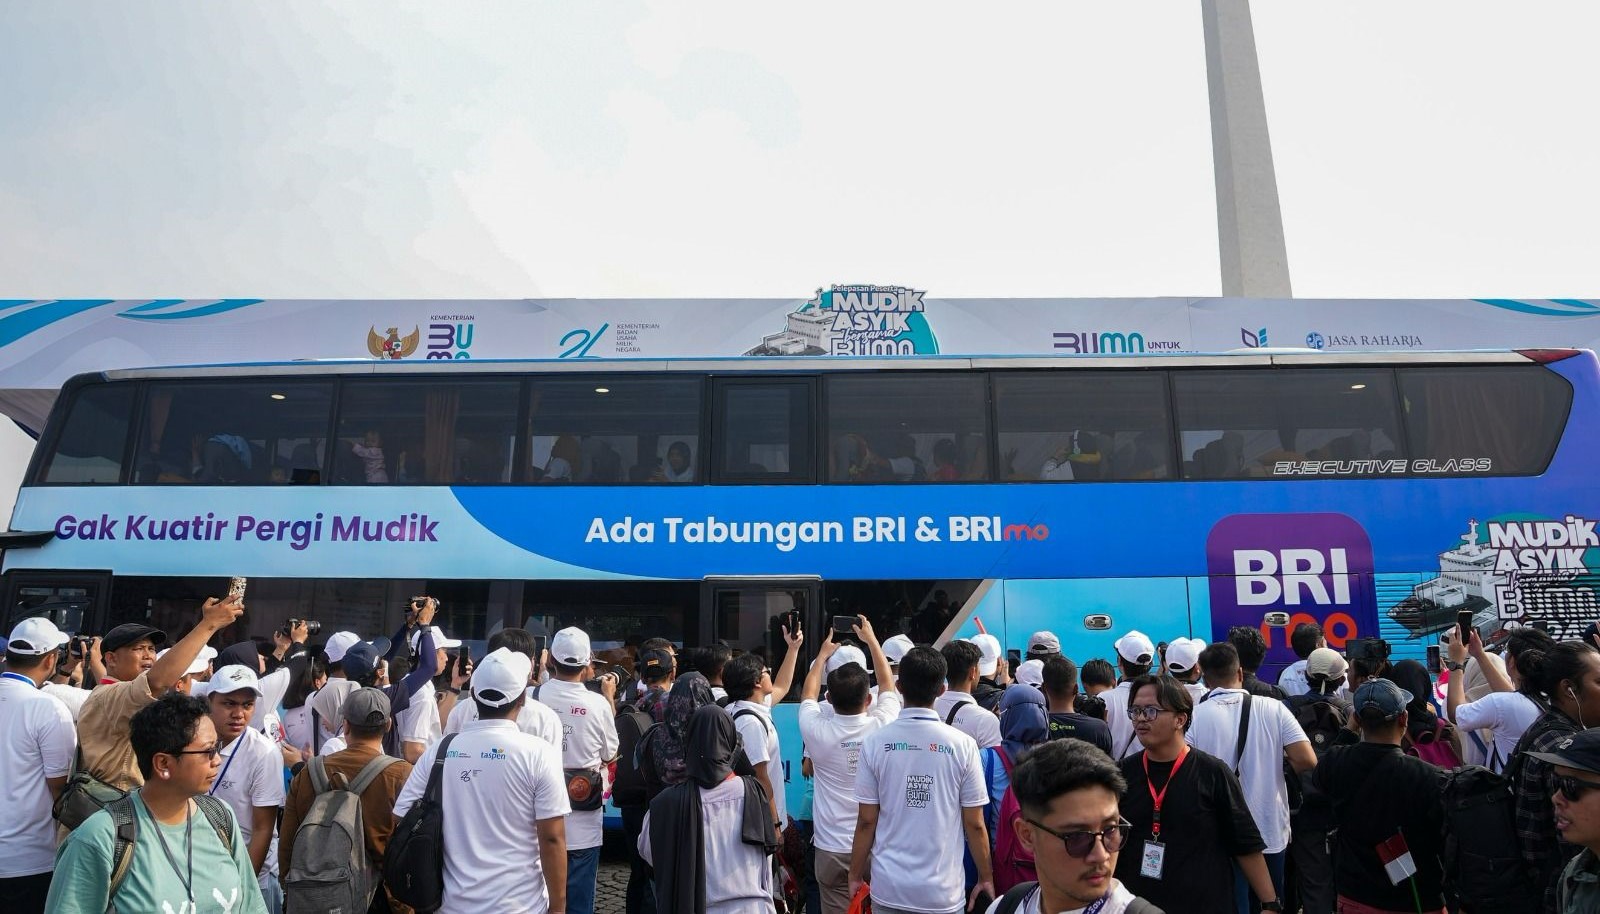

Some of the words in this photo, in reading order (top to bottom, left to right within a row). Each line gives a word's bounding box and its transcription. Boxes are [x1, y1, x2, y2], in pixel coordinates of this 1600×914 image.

[831, 312, 911, 331] ASYIK
[842, 328, 902, 345] bersama
[1328, 336, 1357, 347] JASA
[1361, 335, 1422, 347] RAHARJA
[1147, 341, 1180, 349] UNTUK
[1273, 459, 1407, 474] EXECUTIVE
[1411, 458, 1492, 473] CLASS
[54, 514, 118, 541] Gak
[125, 513, 228, 541] Kuatir
[235, 513, 324, 551] Pergi
[331, 513, 440, 542] Mudik
[584, 518, 654, 543] Ada
[664, 517, 843, 552] Tabungan
[852, 517, 906, 542] BRI
[914, 517, 941, 542] &
[1494, 548, 1590, 575] ASYIK
[1233, 548, 1351, 606] BRI
[481, 752, 506, 760] taspen
[938, 745, 954, 756] BNI
[906, 782, 930, 791] ASYIK
